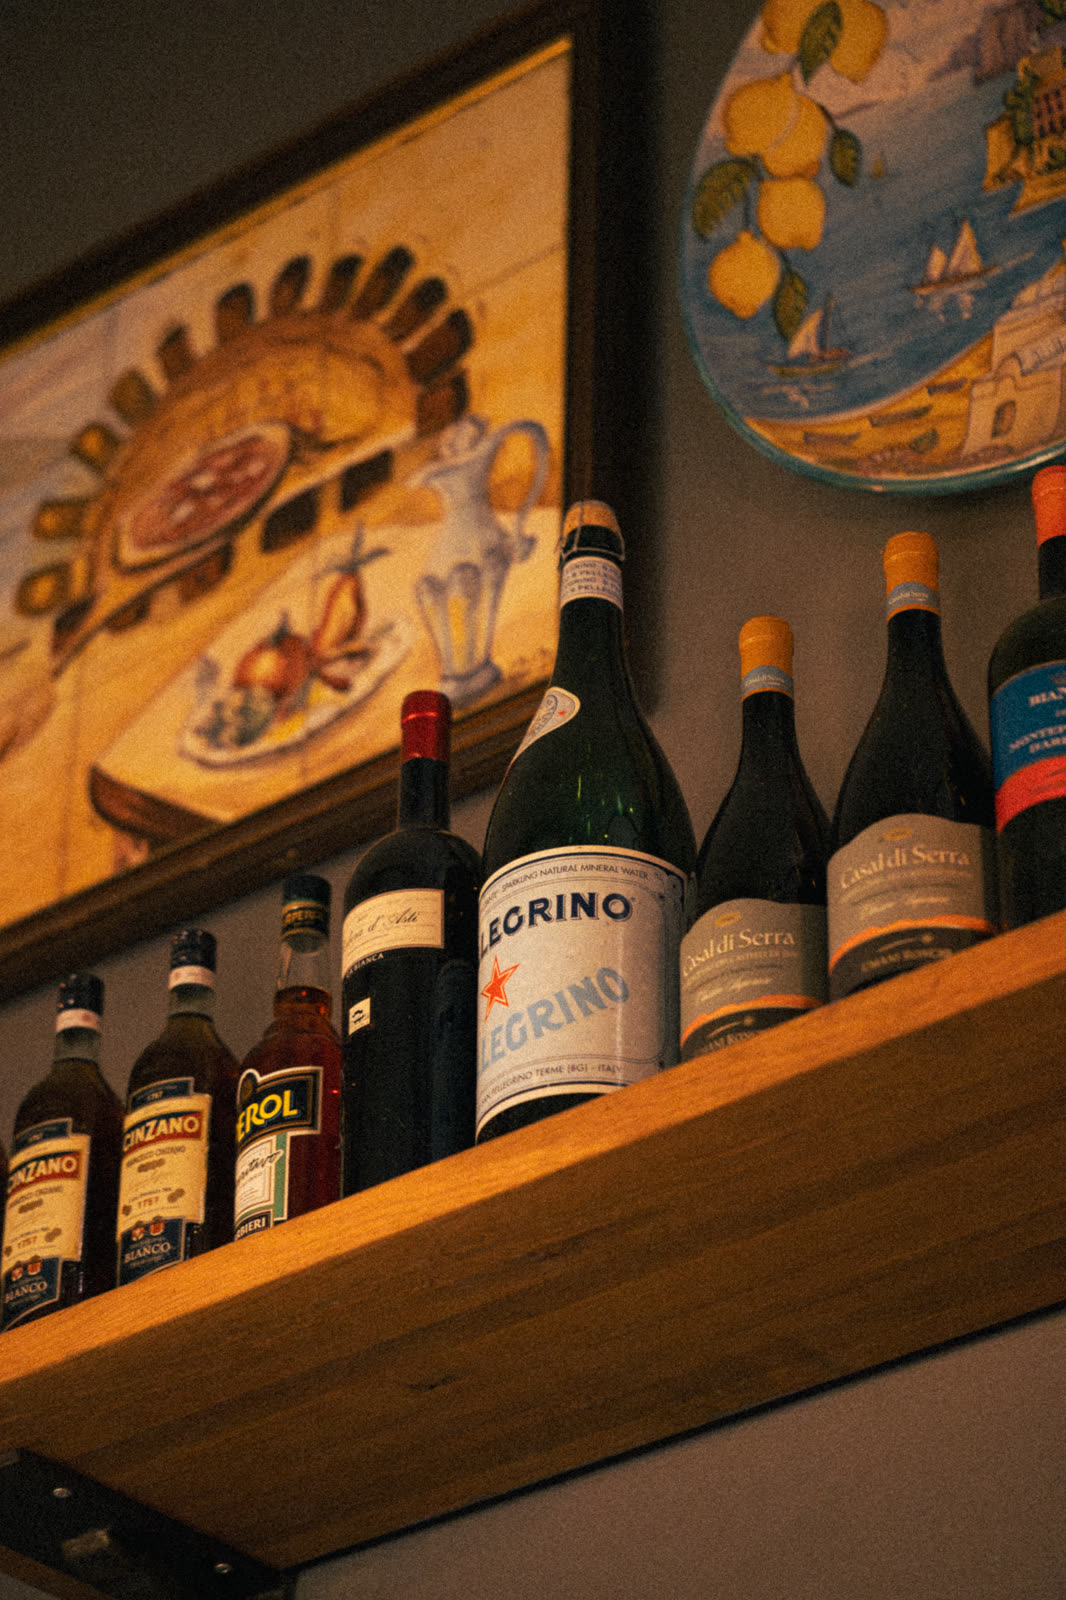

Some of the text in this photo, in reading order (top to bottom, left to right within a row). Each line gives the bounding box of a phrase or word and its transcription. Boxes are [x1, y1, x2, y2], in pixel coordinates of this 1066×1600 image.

[886, 848, 907, 868] di
[911, 844, 971, 865] Serra
[540, 864, 578, 877] NATURAL
[580, 864, 619, 874] MINERAL
[621, 866, 648, 880] WATER
[717, 934, 734, 954] di
[738, 928, 795, 948] Serra
[536, 1066, 564, 1076] TERME
[598, 1065, 622, 1074] ITALY
[236, 1090, 299, 1142] EROL
[122, 1116, 199, 1152] CINZANO
[124, 1242, 170, 1263] BIANCO
